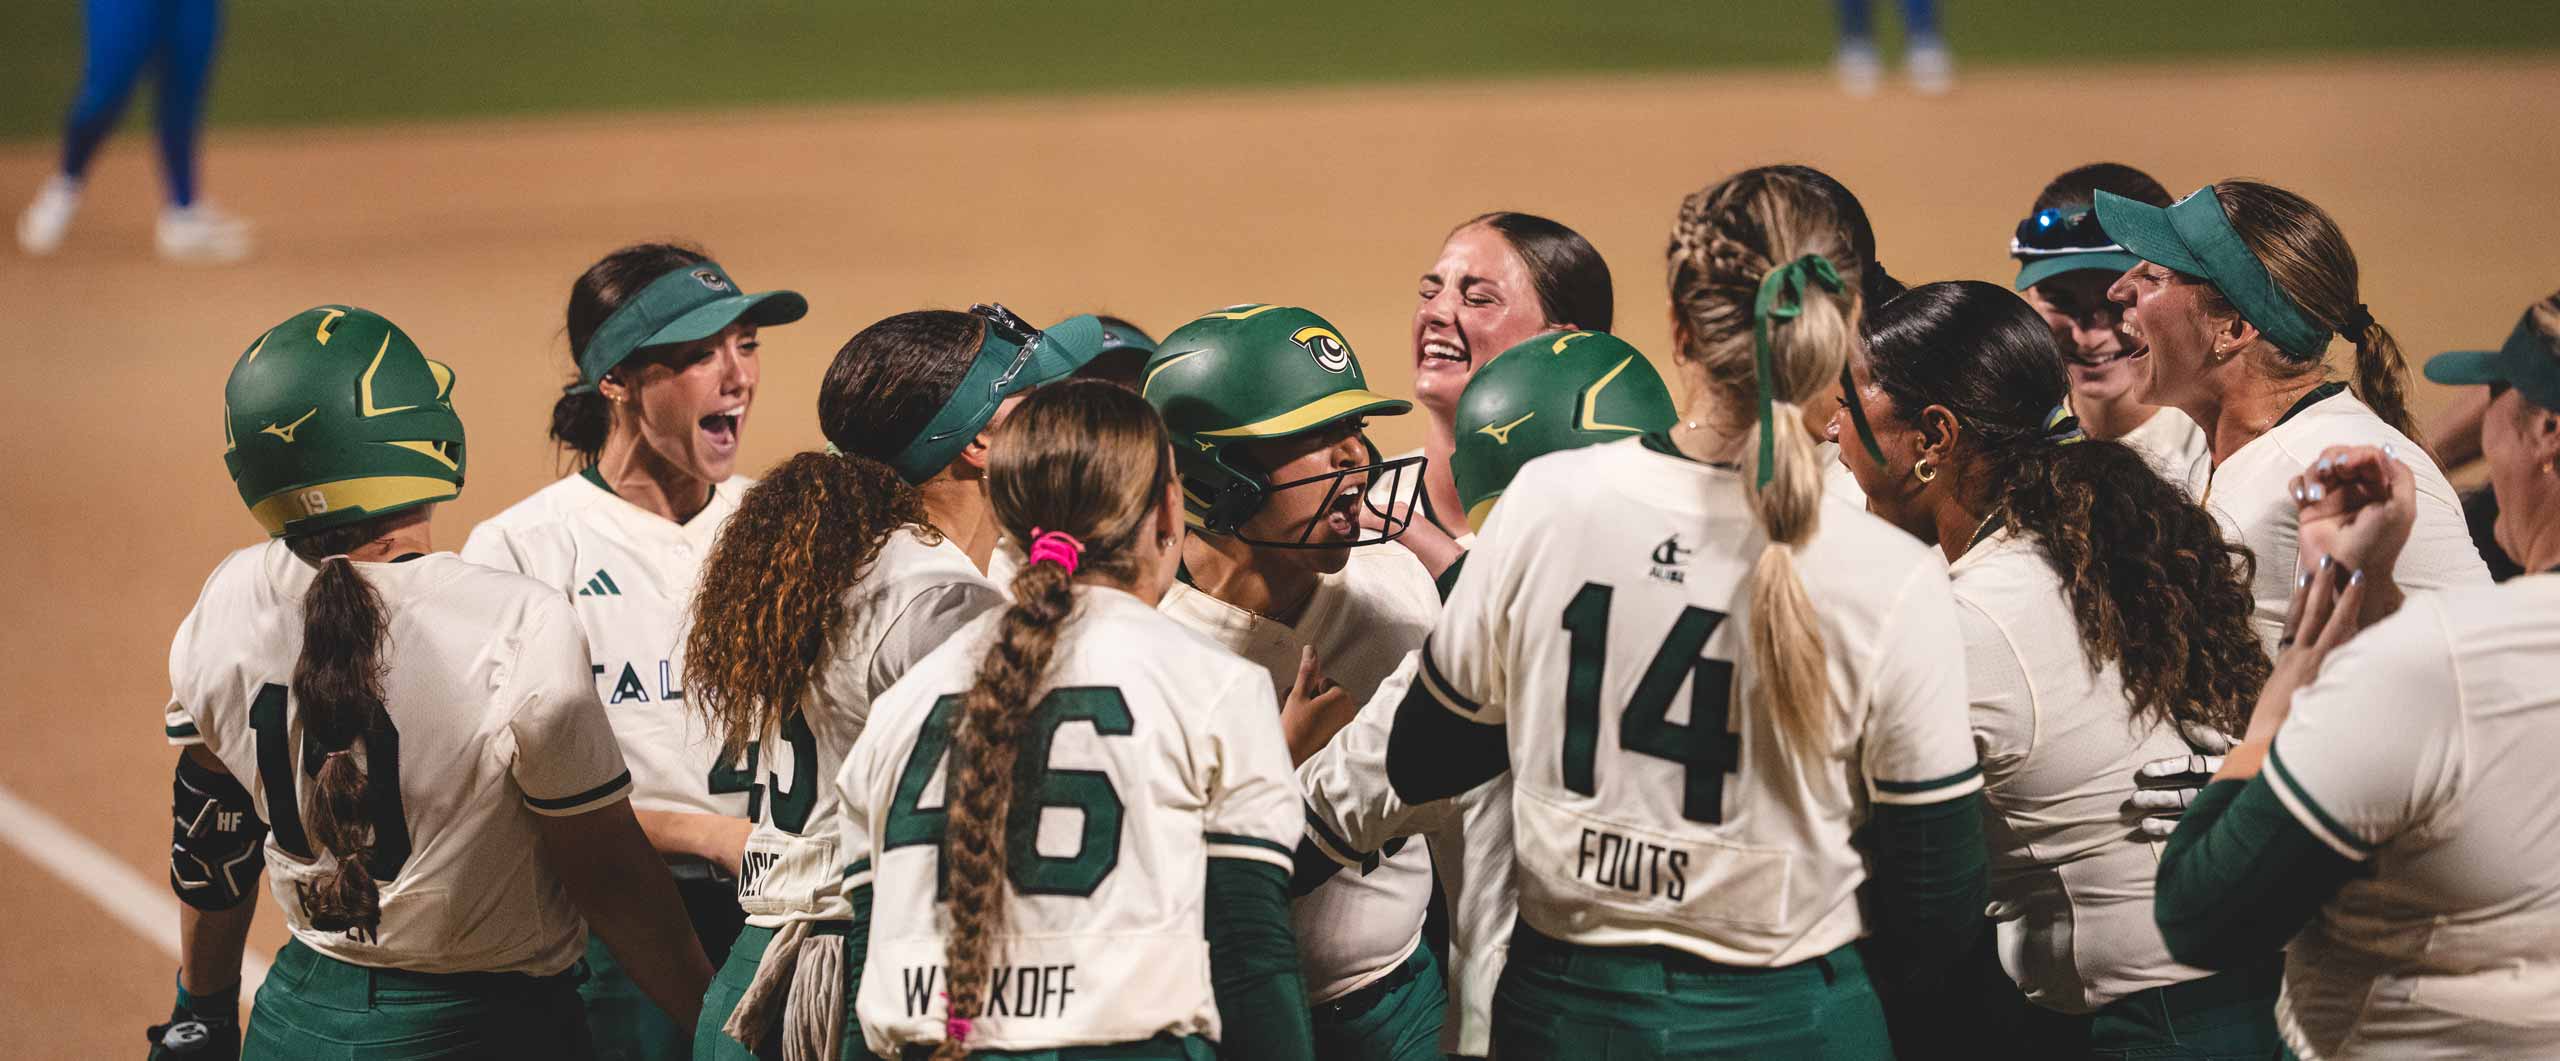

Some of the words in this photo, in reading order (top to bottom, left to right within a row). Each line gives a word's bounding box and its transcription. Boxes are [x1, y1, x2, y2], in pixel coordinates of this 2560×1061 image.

[300, 491, 328, 515] 19
[1562, 581, 1742, 826] 14
[217, 812, 242, 832] HF
[883, 686, 1134, 902] 46
[1578, 827, 1689, 901] FOUTS
[904, 966, 1076, 1017] WKOFF
